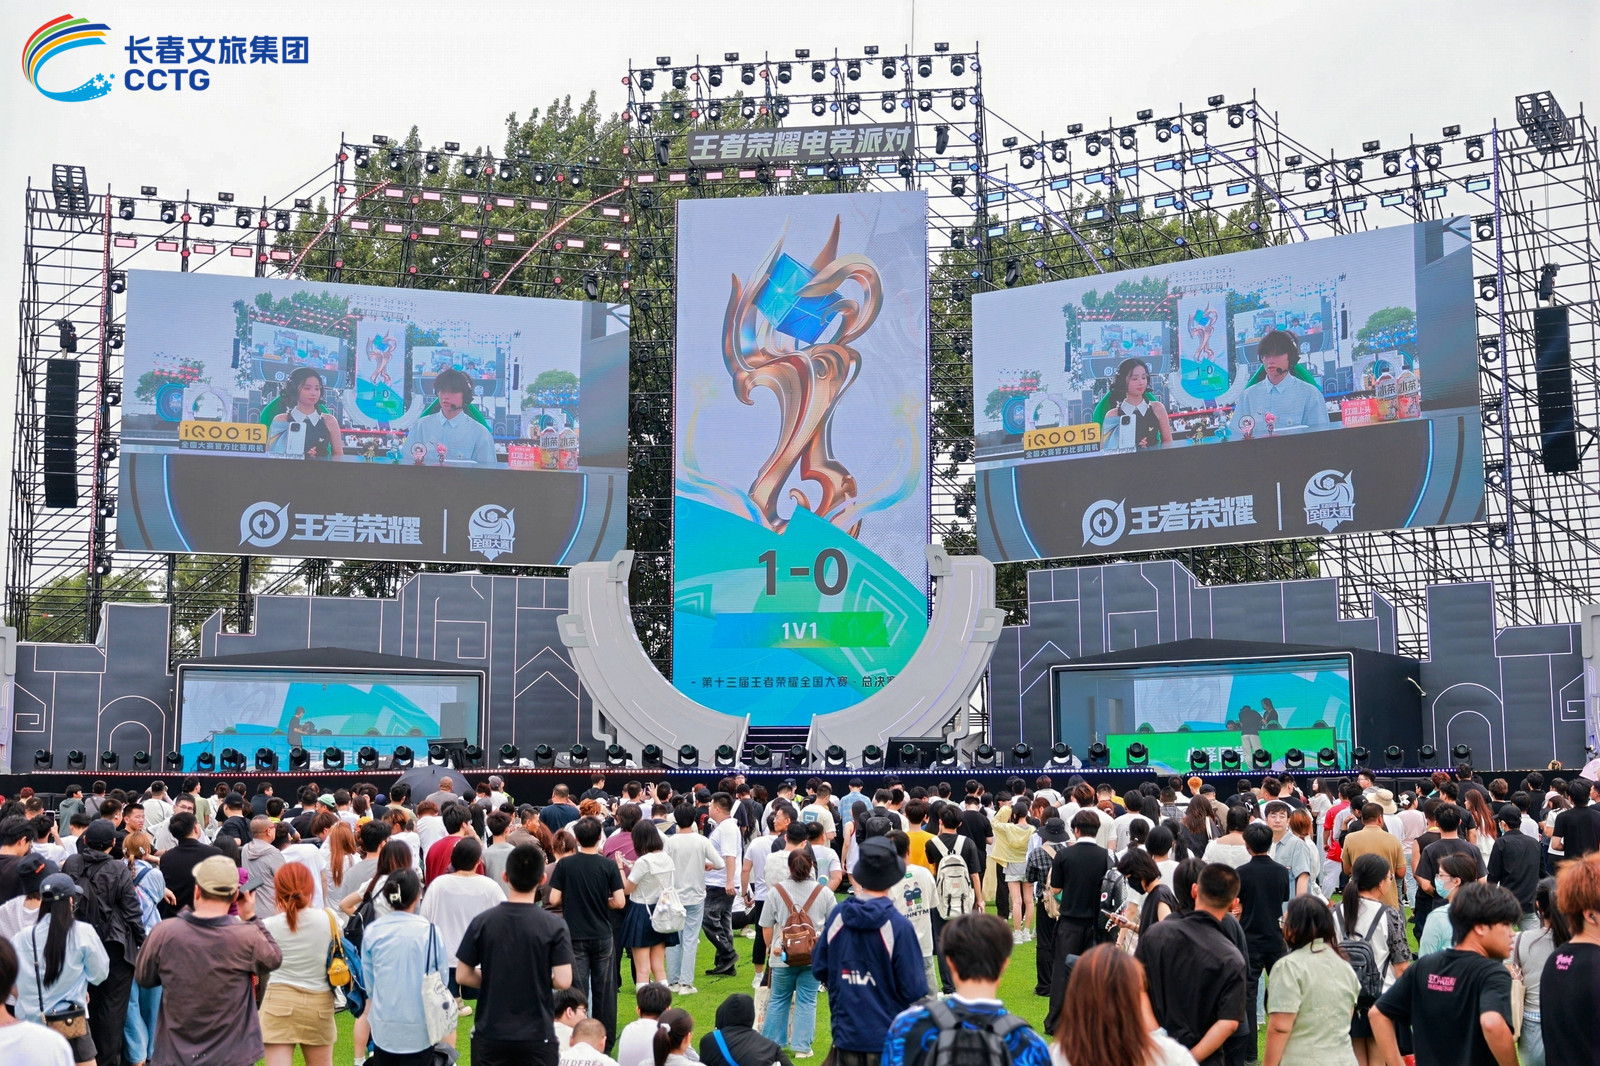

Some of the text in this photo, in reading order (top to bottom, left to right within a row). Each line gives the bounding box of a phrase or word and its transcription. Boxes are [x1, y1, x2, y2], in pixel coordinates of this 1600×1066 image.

[693, 126, 912, 160] 王者荣耀电竞派对
[184, 424, 262, 441] iQOO 15
[1028, 427, 1096, 447] iQOO 15
[1128, 494, 1257, 535] 王者荣耀
[1309, 507, 1350, 521] 全国大赛
[290, 512, 423, 545] 王者荣耀
[472, 538, 510, 550] 全国大赛
[757, 548, 848, 597] 1-0
[781, 621, 818, 640] 1V1
[841, 969, 877, 987] FILA
